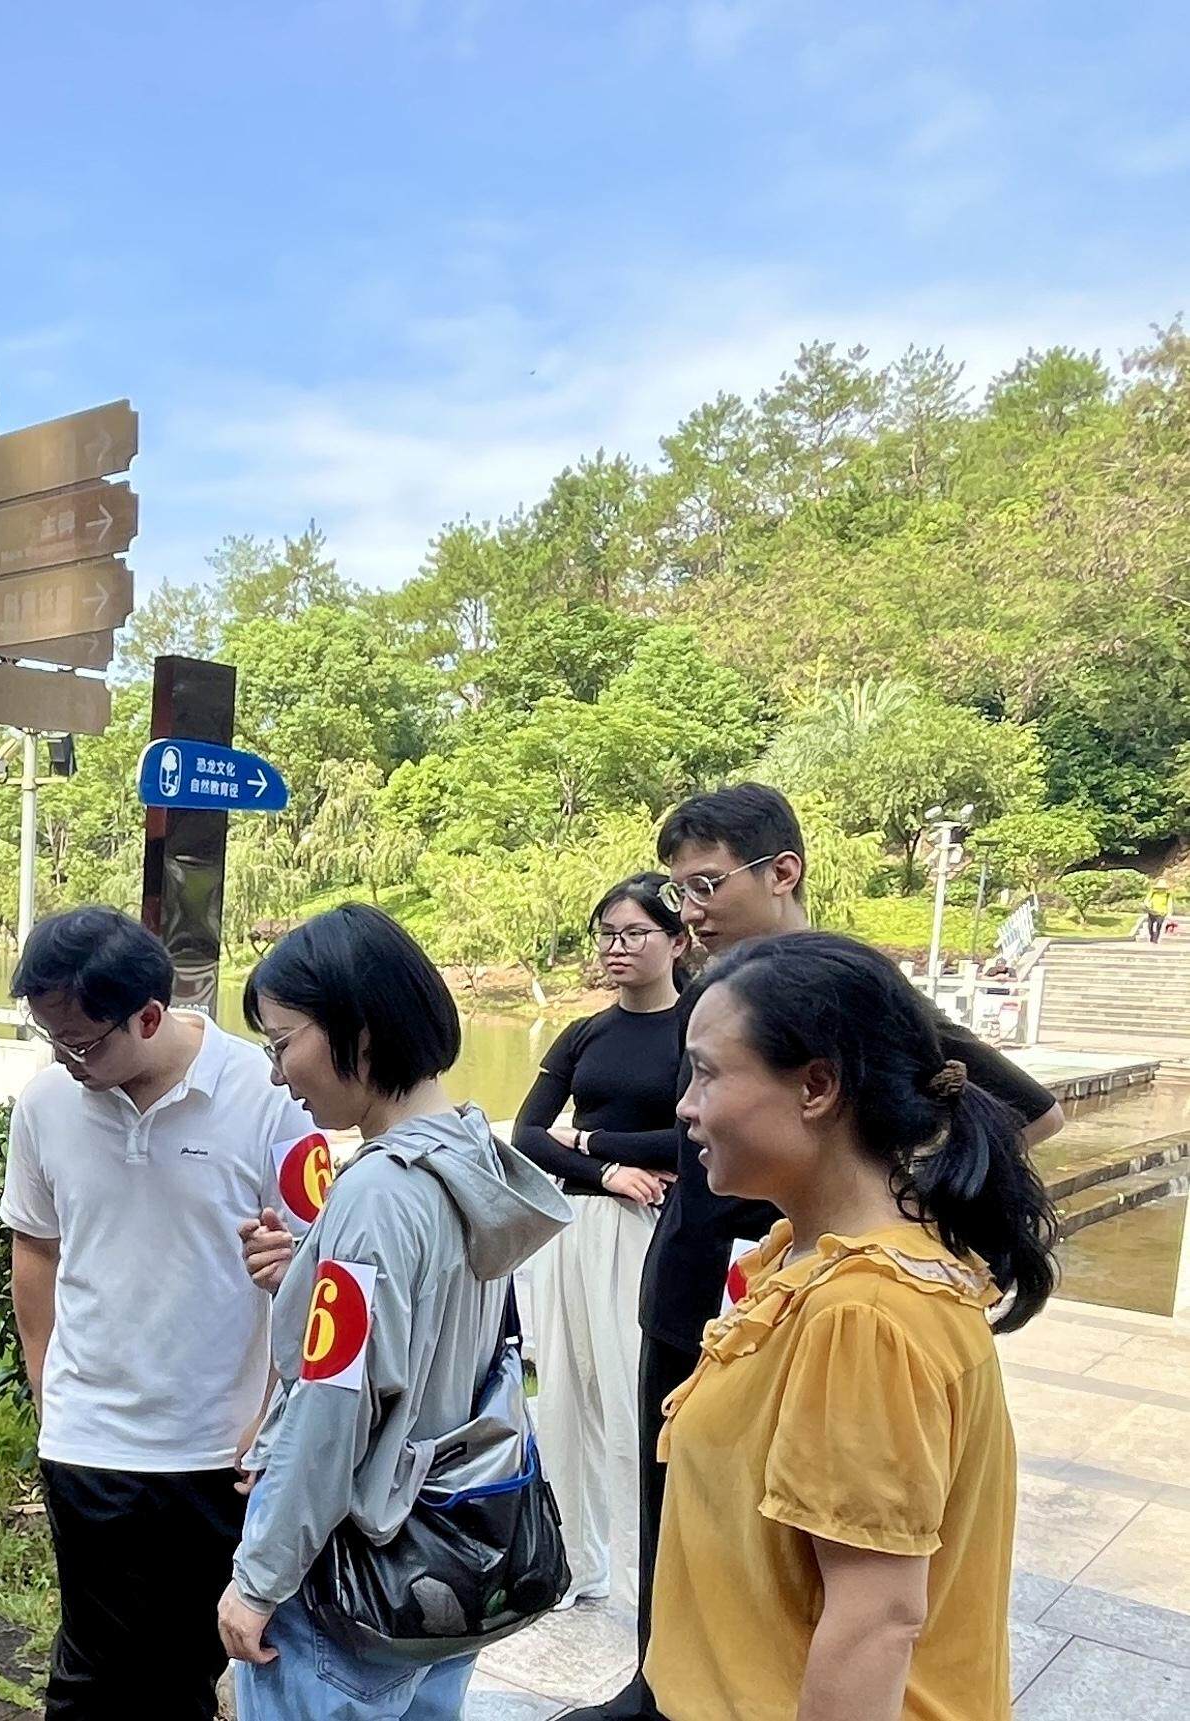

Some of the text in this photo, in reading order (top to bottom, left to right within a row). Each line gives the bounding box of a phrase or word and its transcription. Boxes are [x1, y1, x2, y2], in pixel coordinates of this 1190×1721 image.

[190, 778, 239, 798] 自然教育径
[196, 757, 236, 777] 恐龙文化
[303, 1145, 333, 1210] 6
[303, 1277, 338, 1362] 6
